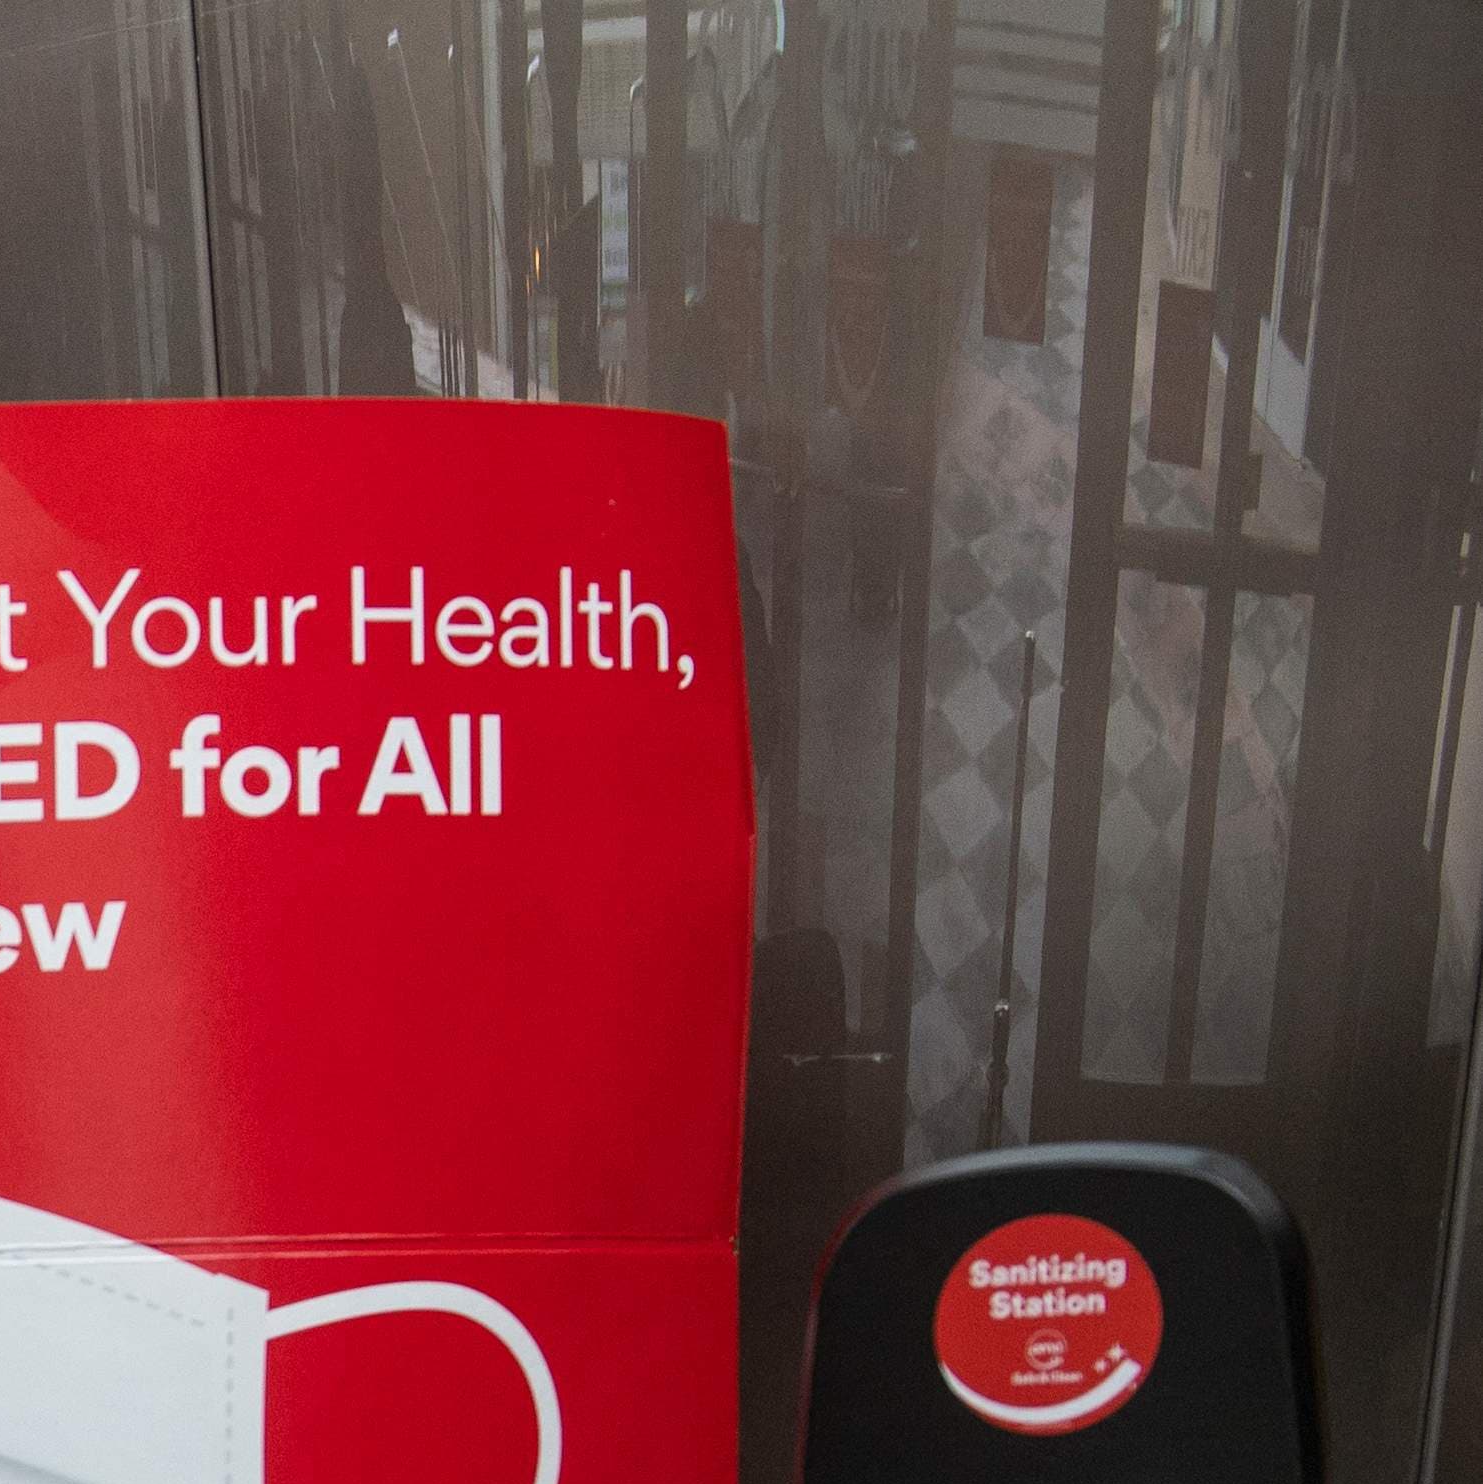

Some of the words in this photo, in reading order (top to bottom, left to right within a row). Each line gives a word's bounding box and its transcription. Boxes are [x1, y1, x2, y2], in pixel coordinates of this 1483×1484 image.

[57, 569, 317, 669] Your
[351, 566, 694, 688] Health,
[169, 714, 339, 817] for
[358, 714, 501, 815] All
[969, 1253, 1128, 1289] Sanitizing
[989, 1287, 1106, 1320] Station
